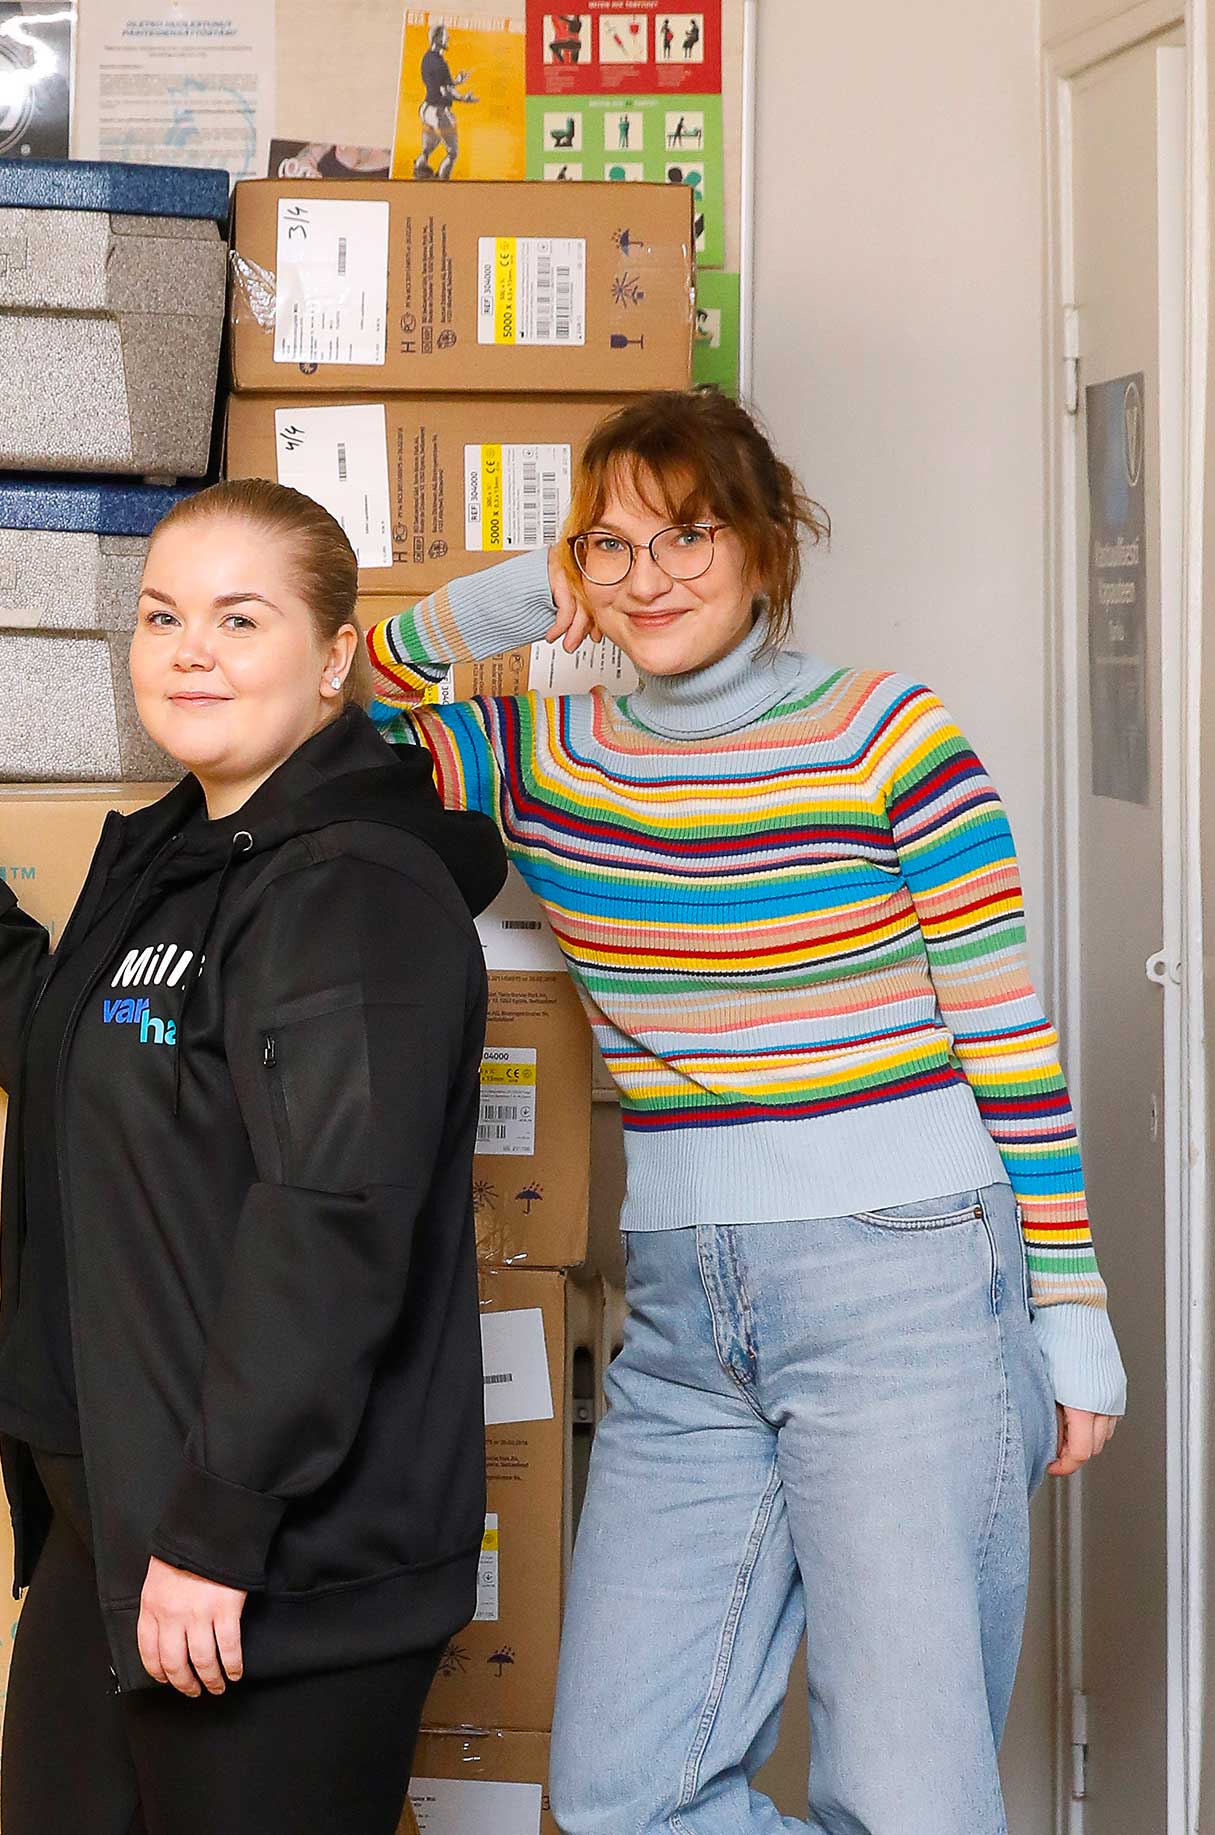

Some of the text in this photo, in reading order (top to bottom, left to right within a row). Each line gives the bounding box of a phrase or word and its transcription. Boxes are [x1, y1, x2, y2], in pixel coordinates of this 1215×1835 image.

[283, 205, 310, 240] 3/4
[503, 312, 513, 337] 5000
[279, 424, 305, 451] 4/4
[485, 460, 496, 473] CE
[470, 471, 478, 520] REF 304000
[490, 519, 500, 545] 5000
[103, 997, 151, 1024] var
[483, 1052, 509, 1060] 04000
[506, 1068, 520, 1079] CE
